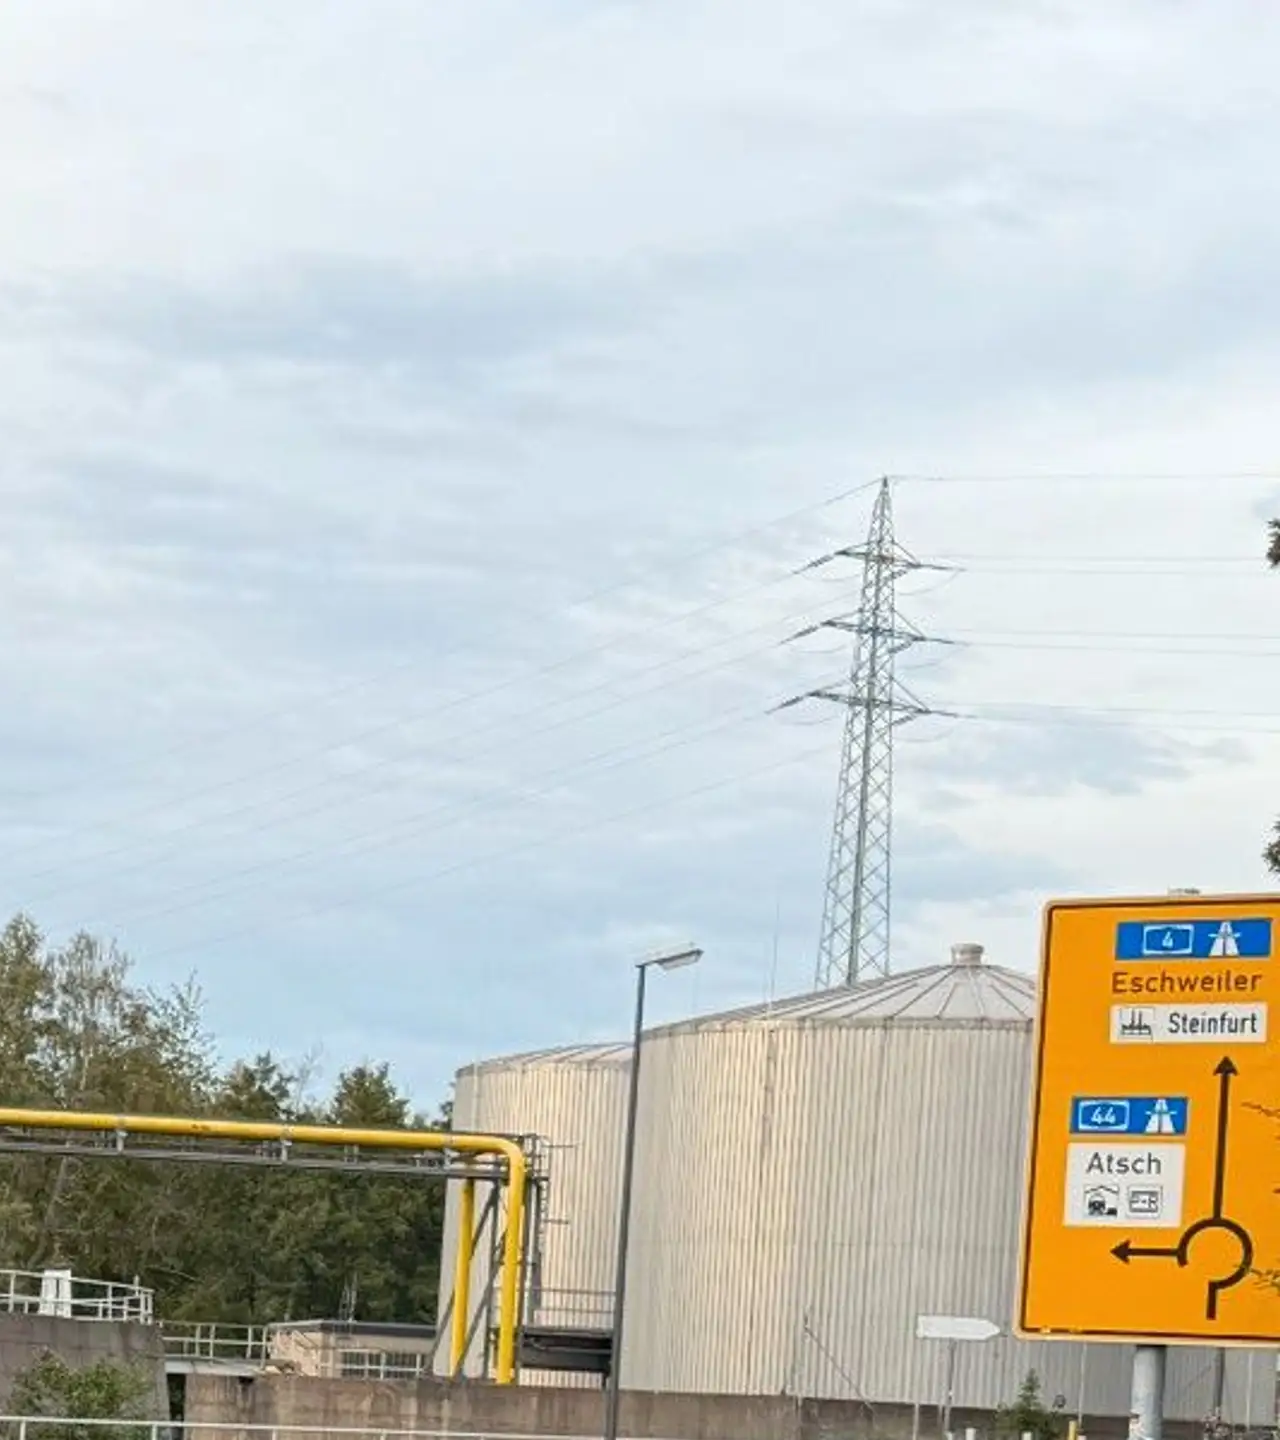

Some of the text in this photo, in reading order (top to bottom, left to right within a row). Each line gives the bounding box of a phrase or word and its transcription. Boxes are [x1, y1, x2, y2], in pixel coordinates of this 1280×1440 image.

[1161, 931, 1174, 948] 4
[1111, 969, 1263, 994] Eschweiler
[1168, 1012, 1257, 1034] Steinfurt
[1090, 1106, 1116, 1124] 44
[1085, 1151, 1162, 1175] Atsch
